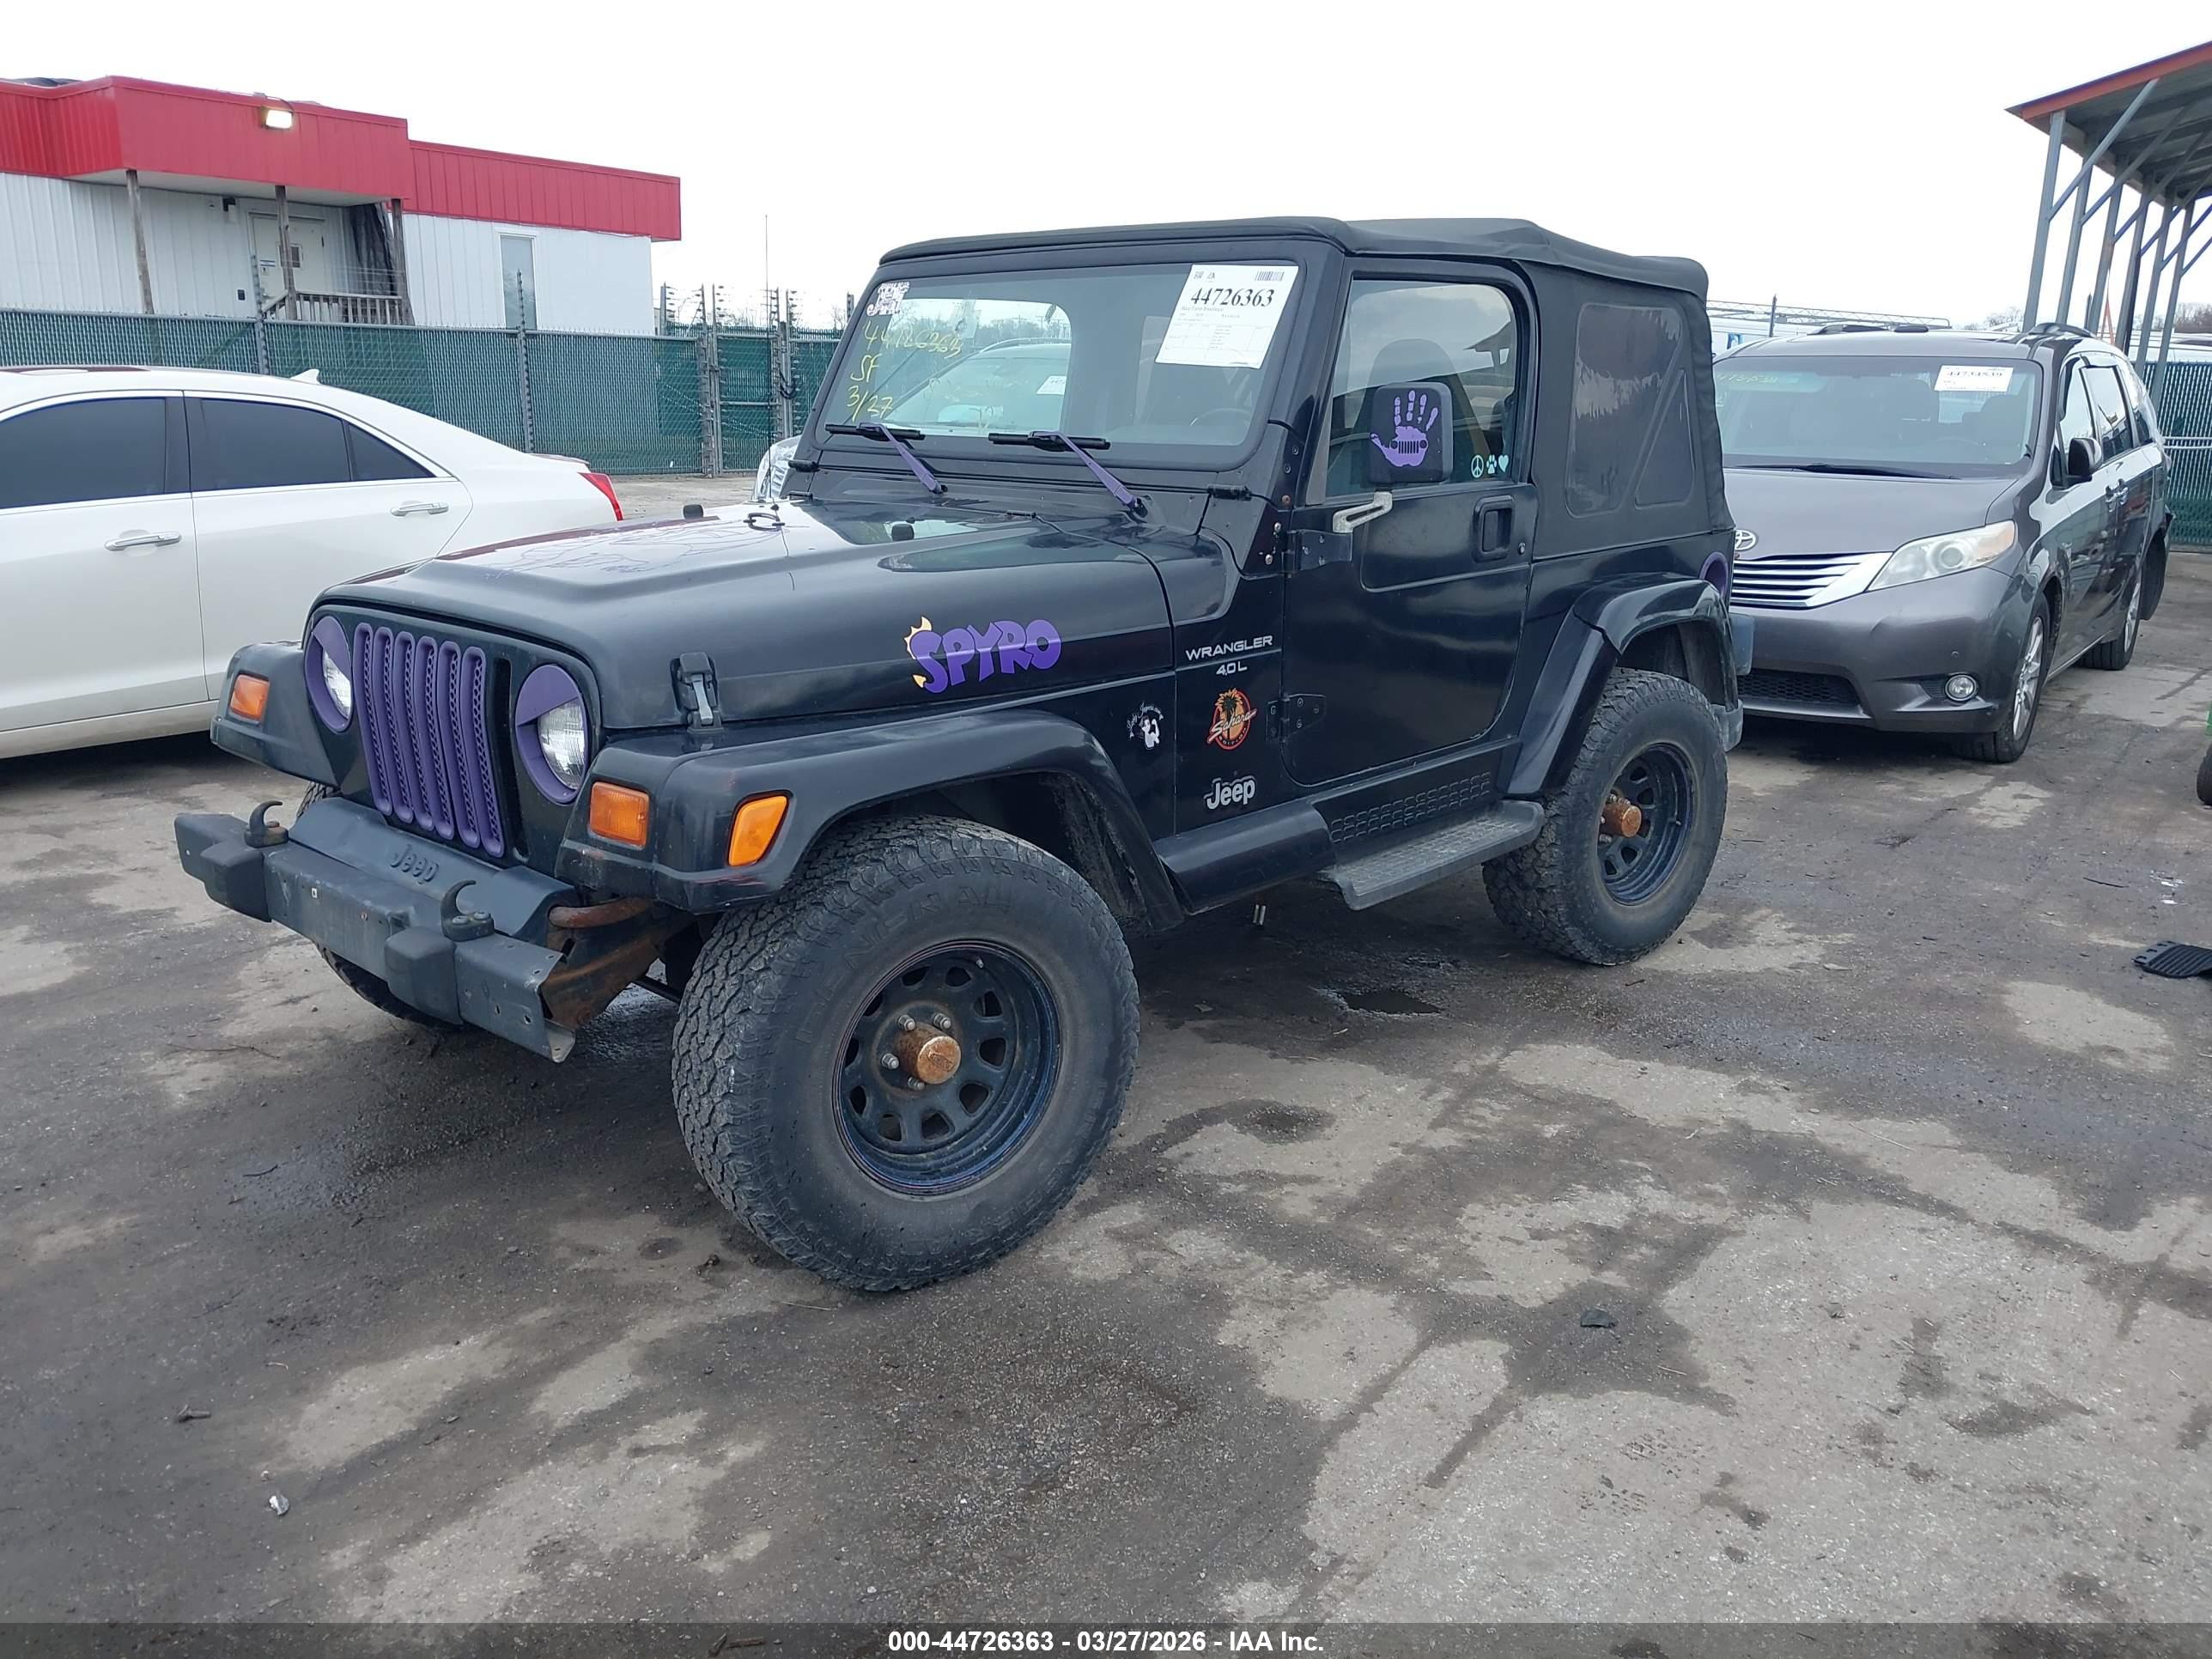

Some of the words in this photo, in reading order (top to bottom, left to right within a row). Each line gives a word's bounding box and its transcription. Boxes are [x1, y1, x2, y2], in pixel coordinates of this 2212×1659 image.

[1190, 286, 1274, 307] 44726363
[849, 353, 884, 383] SF
[847, 385, 894, 423] 3/27
[909, 618, 1062, 694] SPYRO
[1185, 635, 1273, 661] WRANGLER
[1207, 708, 1258, 744] Sahara
[1204, 778, 1255, 809] Jeep
[390, 843, 440, 885] Jeep
